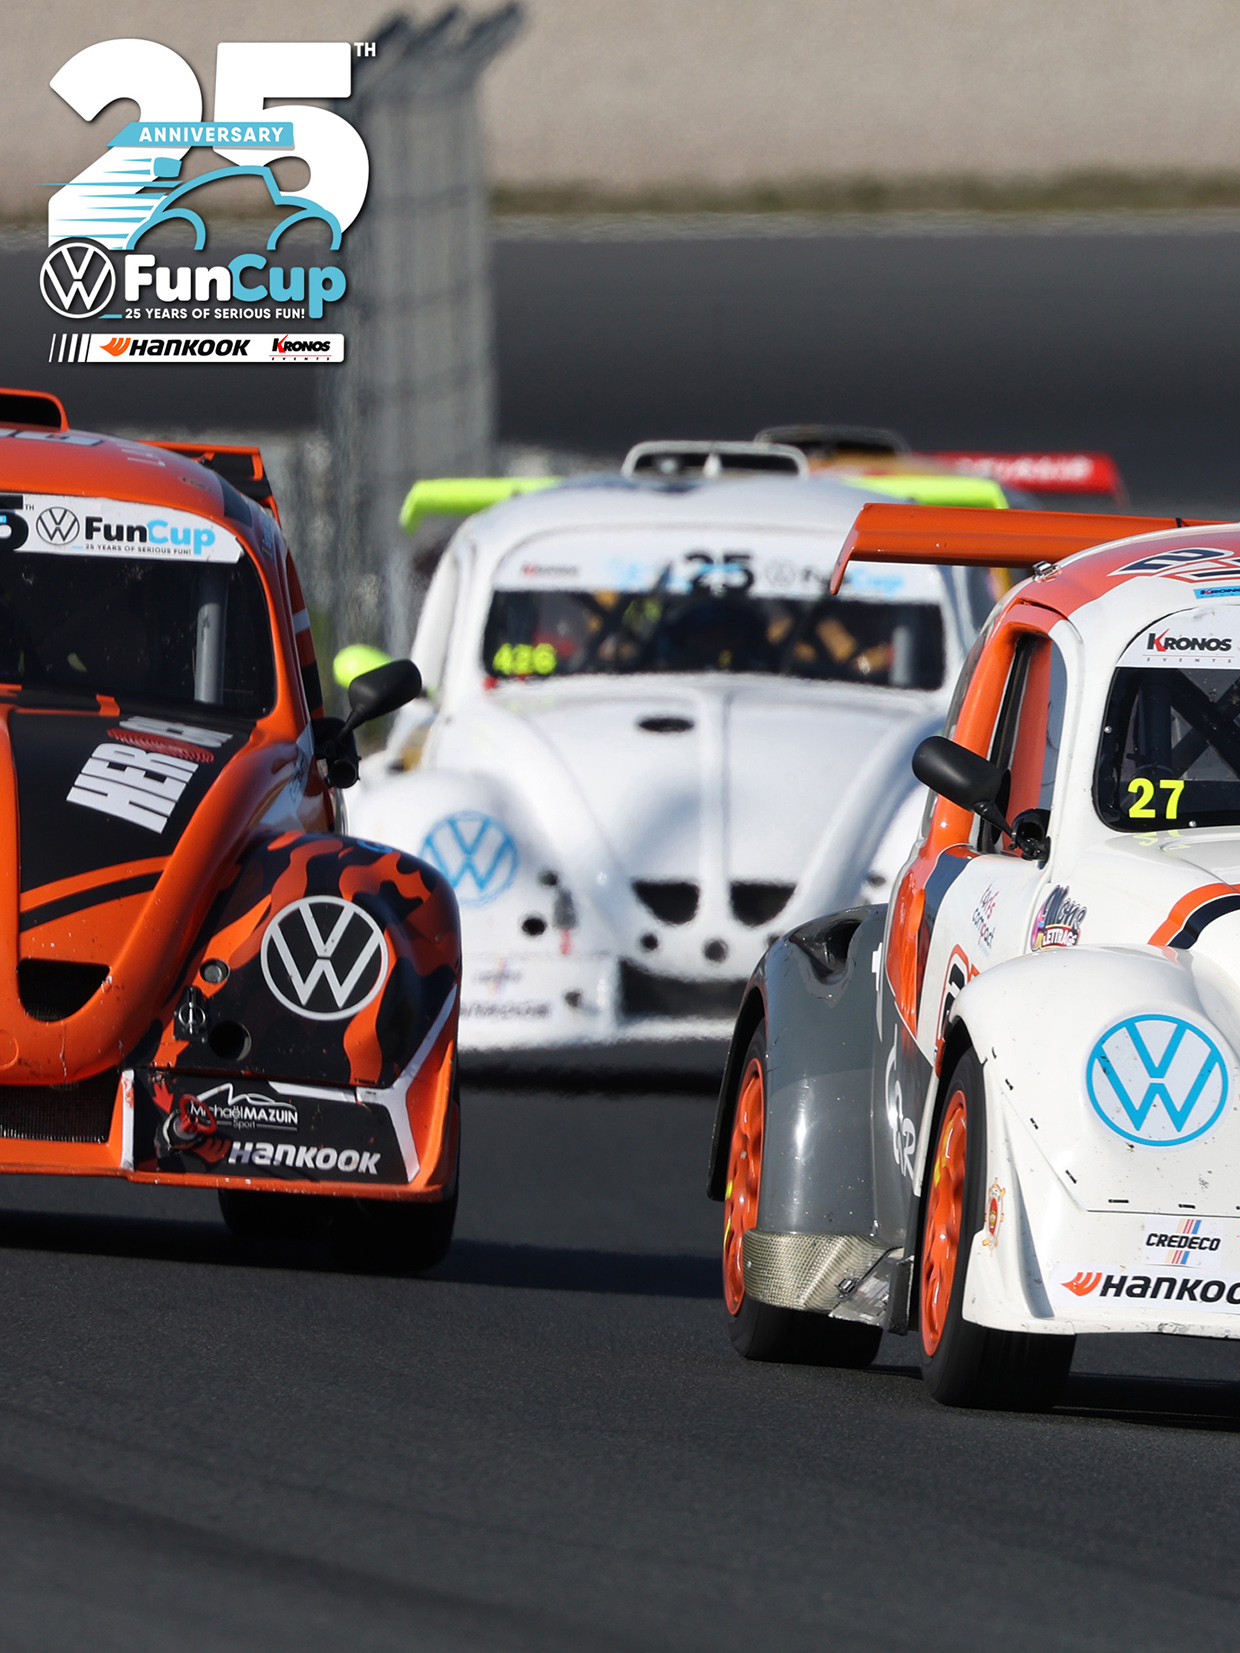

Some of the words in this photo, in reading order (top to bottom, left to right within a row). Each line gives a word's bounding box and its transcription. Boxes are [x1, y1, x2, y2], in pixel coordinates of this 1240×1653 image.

[85, 516, 216, 554] FunCup
[97, 543, 119, 551] YEARS
[137, 546, 171, 554] SERIOUS
[1147, 629, 1233, 652] KRONOS
[1146, 656, 1232, 664] EVENTS
[1128, 778, 1185, 819] 27
[1146, 1233, 1221, 1251] CREDECO
